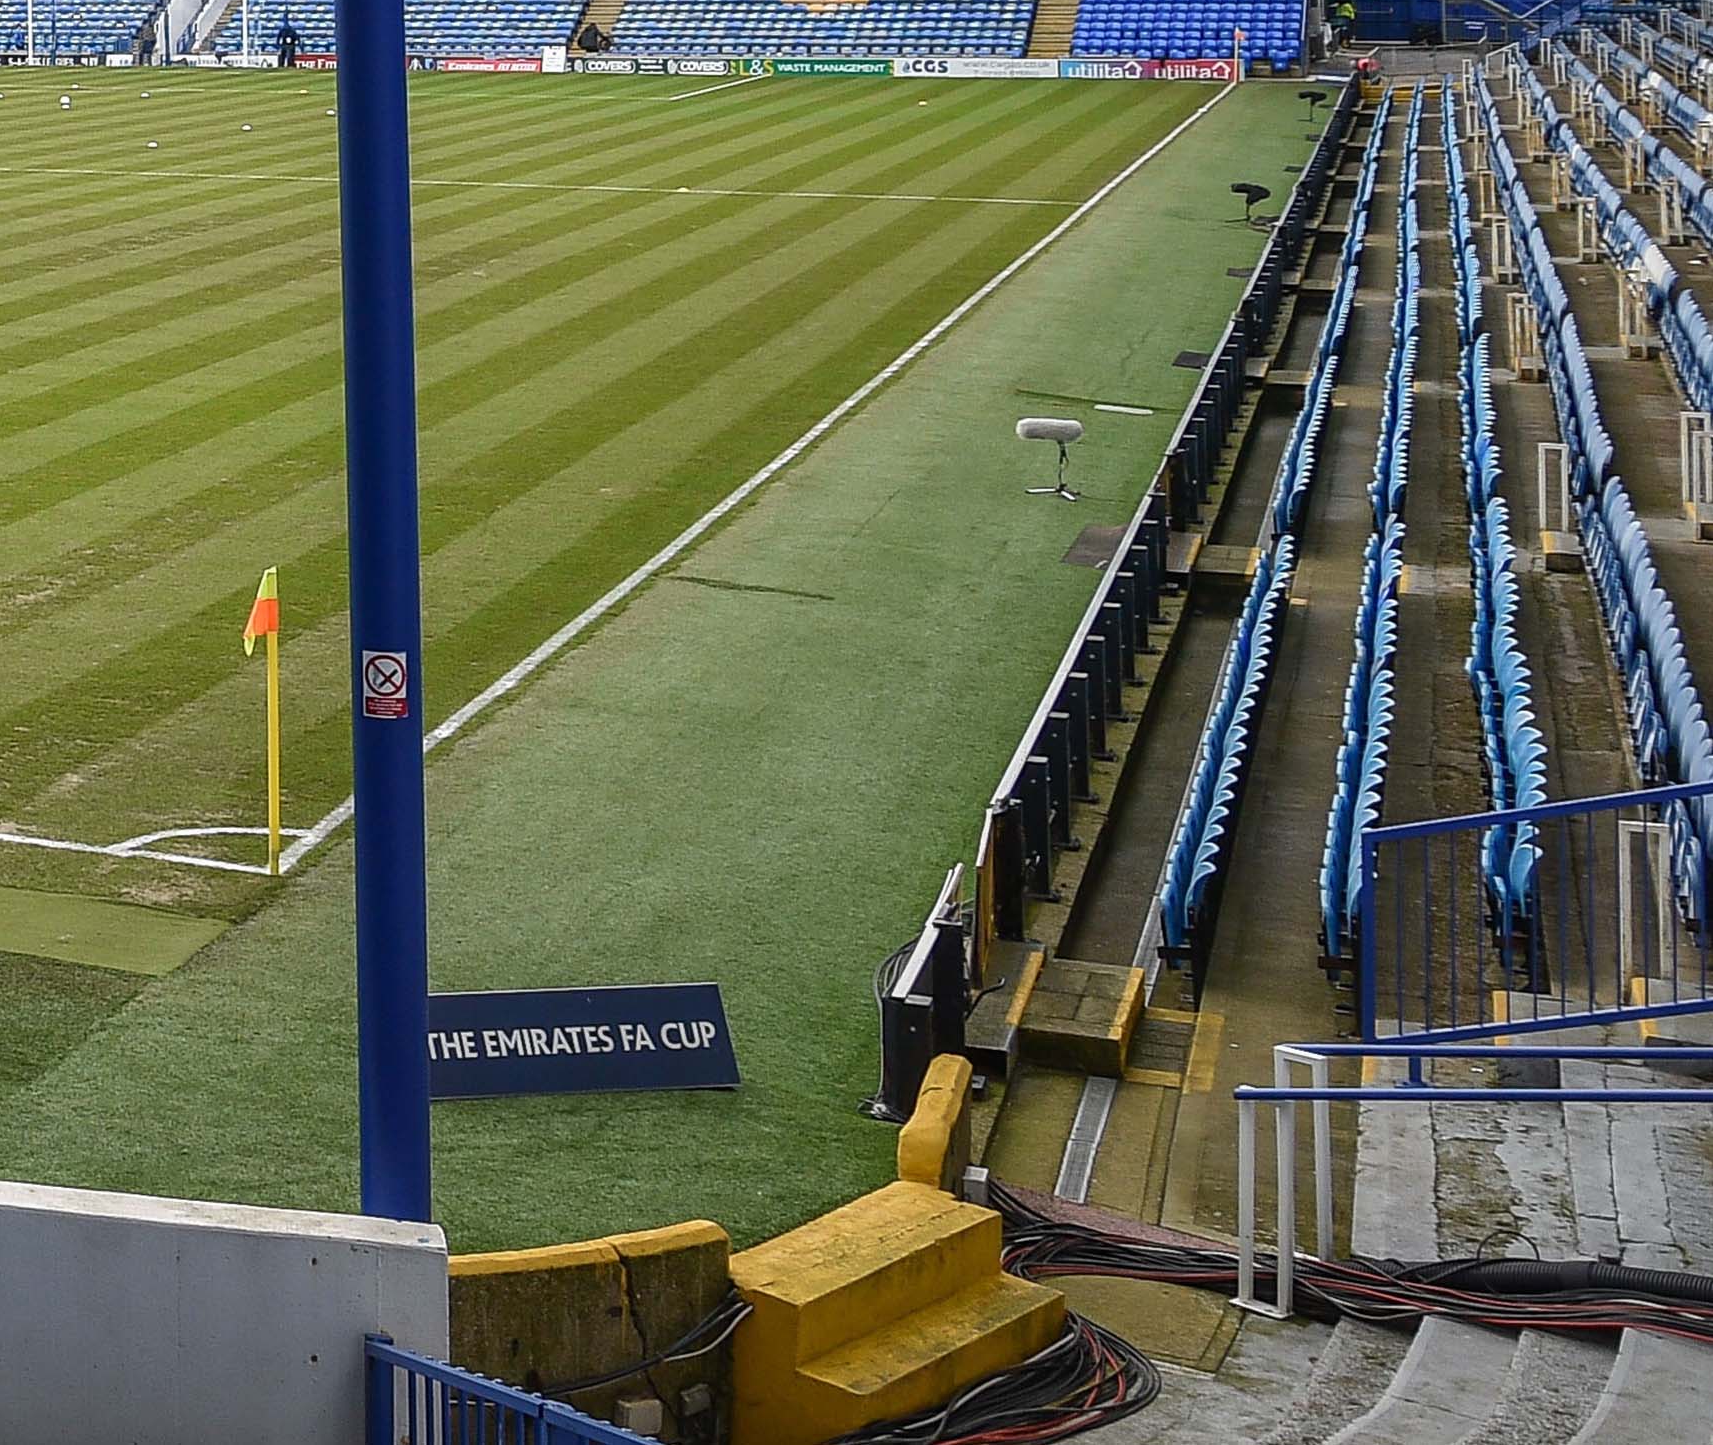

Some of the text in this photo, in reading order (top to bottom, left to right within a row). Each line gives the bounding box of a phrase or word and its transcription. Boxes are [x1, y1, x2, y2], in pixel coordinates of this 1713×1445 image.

[588, 60, 631, 71] COVERS
[680, 60, 725, 72] COVERS
[740, 59, 885, 76] L&S WASTE MANAGEMENT
[912, 60, 948, 73] CGS
[1068, 63, 1123, 78] utilita
[1154, 63, 1211, 79] utilita
[428, 1022, 717, 1061] THE EMIRATES FA CUP
